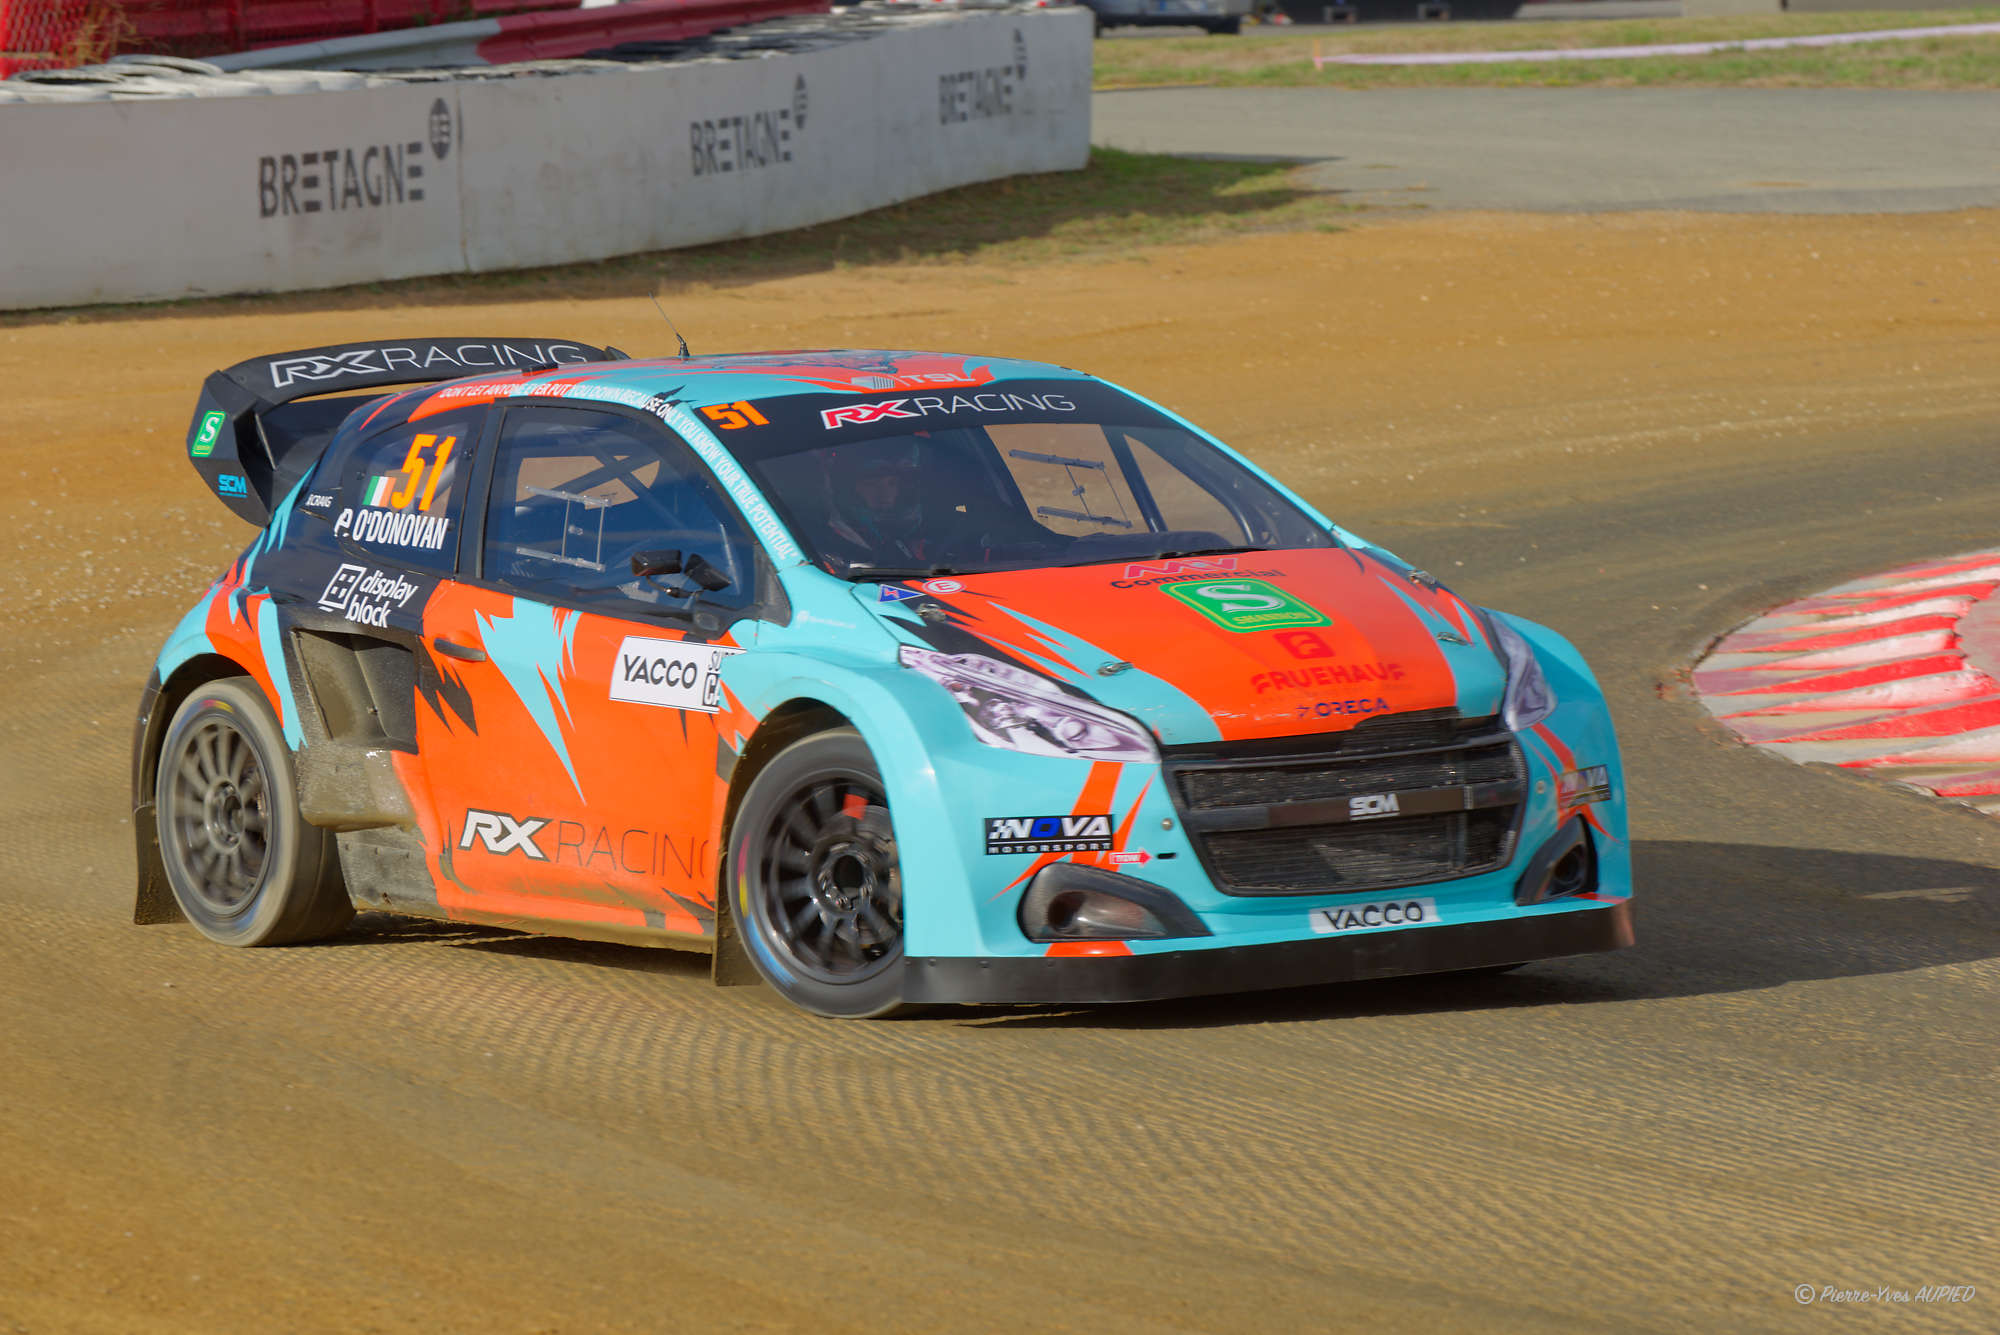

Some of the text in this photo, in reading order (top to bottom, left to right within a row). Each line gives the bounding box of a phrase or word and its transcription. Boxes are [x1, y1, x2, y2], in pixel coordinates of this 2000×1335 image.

[690, 109, 792, 177] BRETAGNE
[258, 141, 424, 218] BRETAGNE
[901, 373, 976, 384] TSL
[700, 400, 770, 429] 51
[912, 393, 1077, 416] RACING
[391, 433, 456, 512] 51
[714, 456, 741, 488] YOUR
[733, 480, 759, 509] TRUE
[352, 508, 449, 550] O'DONOVAN
[359, 570, 419, 607] display
[1110, 569, 1287, 589] Commercial
[345, 596, 392, 628] block
[623, 654, 698, 689] YACCO
[1250, 662, 1405, 694] FRUEHAUF
[555, 819, 709, 879] RACIN
[988, 842, 1112, 854] MOTORSPORT
[1322, 902, 1423, 930] YACCO
